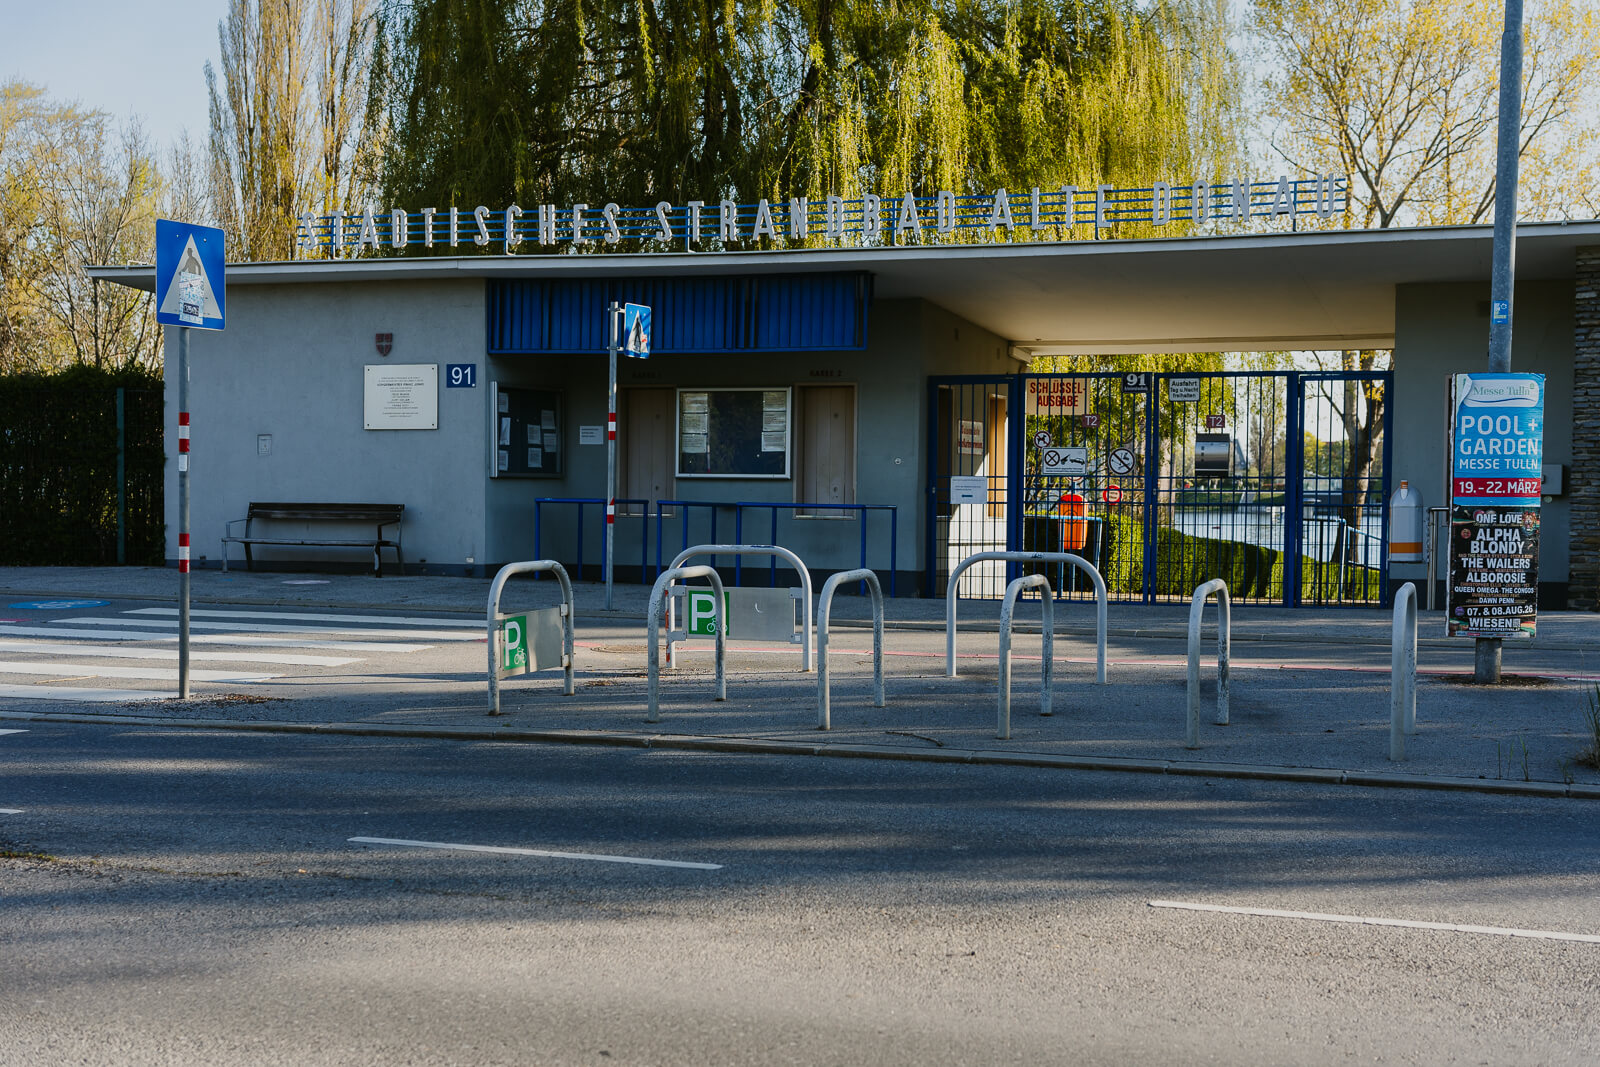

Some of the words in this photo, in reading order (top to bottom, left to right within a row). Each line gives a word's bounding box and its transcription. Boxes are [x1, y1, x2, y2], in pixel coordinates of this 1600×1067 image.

[655, 190, 957, 243] STRANDBAD
[989, 183, 1115, 232] ALTE
[1152, 172, 1336, 226] DONAU
[1126, 374, 1146, 386] 91
[1473, 386, 1504, 396] Messe
[1506, 386, 1530, 396] Tulln
[1037, 395, 1079, 407] AUSGABE
[1085, 416, 1098, 426] T2
[1209, 417, 1222, 427] T2
[1460, 415, 1524, 435] POOL
[1528, 420, 1538, 431] +
[1460, 437, 1538, 456] GARDEN
[1460, 458, 1499, 470] MESSE
[1504, 458, 1538, 470] TULLN
[1507, 479, 1538, 494] MÄRZ
[1476, 513, 1497, 523] ONE
[1499, 514, 1522, 524] LOVE
[1475, 528, 1521, 541] ALPHA
[1470, 540, 1525, 554] BLONDY
[1461, 558, 1484, 568] THE
[1486, 558, 1530, 569] WAILERS
[1466, 572, 1526, 583] ALBOROSIE
[1476, 586, 1499, 594] OMEGA
[691, 593, 716, 632] P
[1466, 607, 1481, 616] 07.
[1482, 607, 1490, 616] &
[1469, 617, 1513, 628] WIESEN
[504, 621, 521, 667] P
